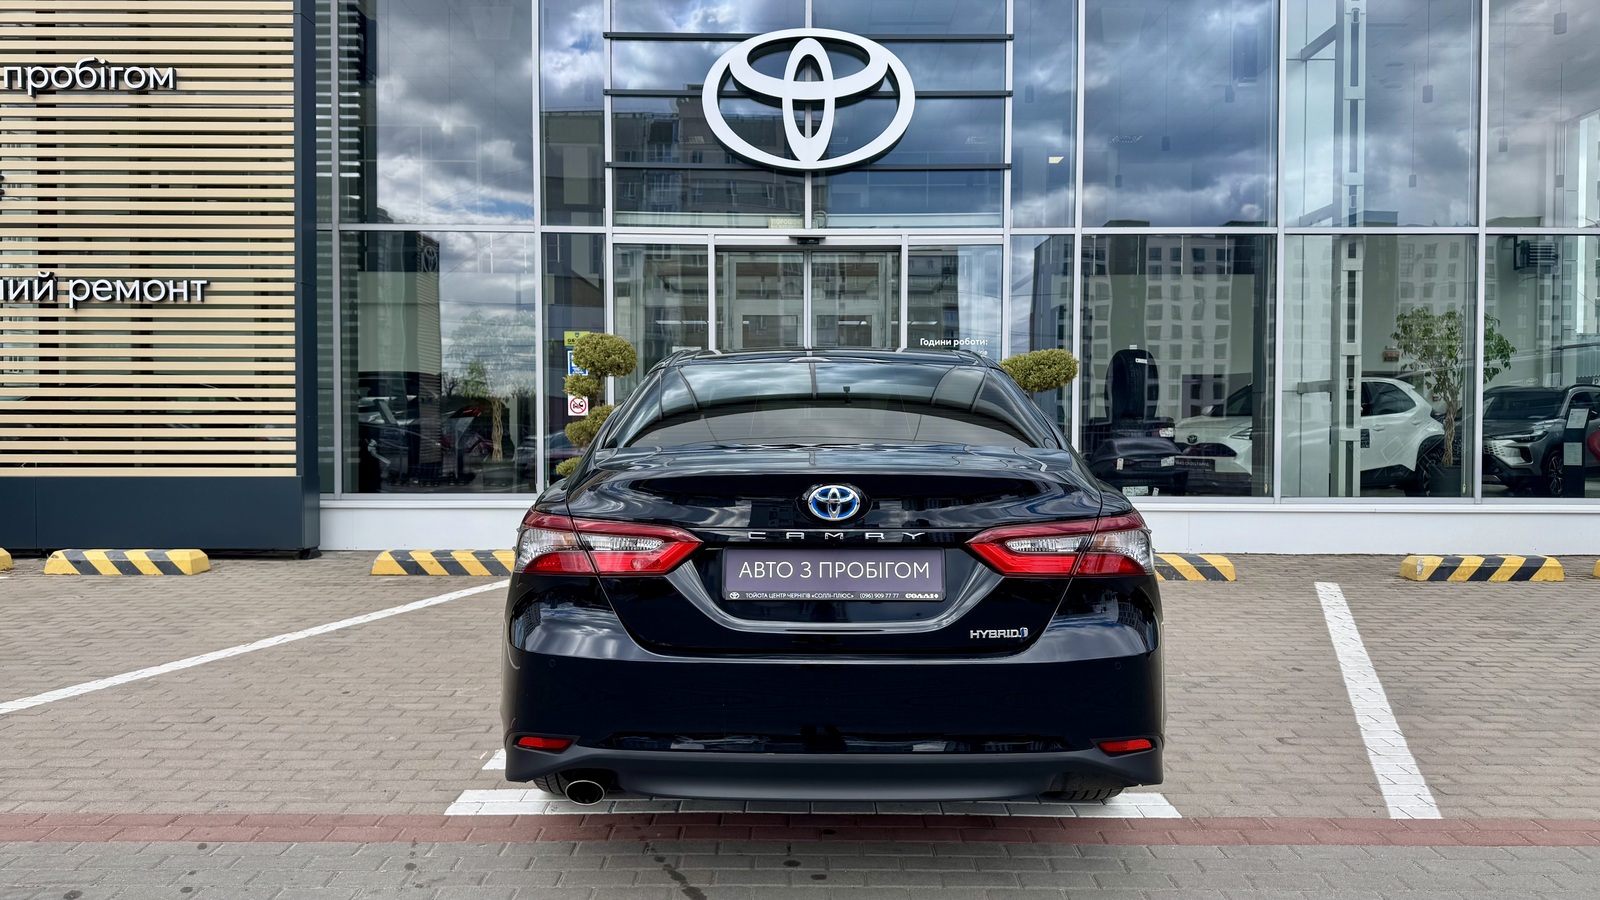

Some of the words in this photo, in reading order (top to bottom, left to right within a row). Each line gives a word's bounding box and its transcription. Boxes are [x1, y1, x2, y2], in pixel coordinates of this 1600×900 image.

[3, 57, 175, 96] пробігом
[0, 271, 57, 301] ий
[68, 278, 208, 309] ремонт
[920, 338, 952, 347] Години
[953, 338, 988, 347] роботи:
[748, 531, 926, 540] CAMRY
[738, 562, 794, 578] АВТО
[819, 562, 930, 579] ПРОБІГОМ
[745, 591, 767, 599] ТОЙОТА
[768, 591, 786, 600] ЦЕНТР
[969, 629, 1021, 639] HYBRID
